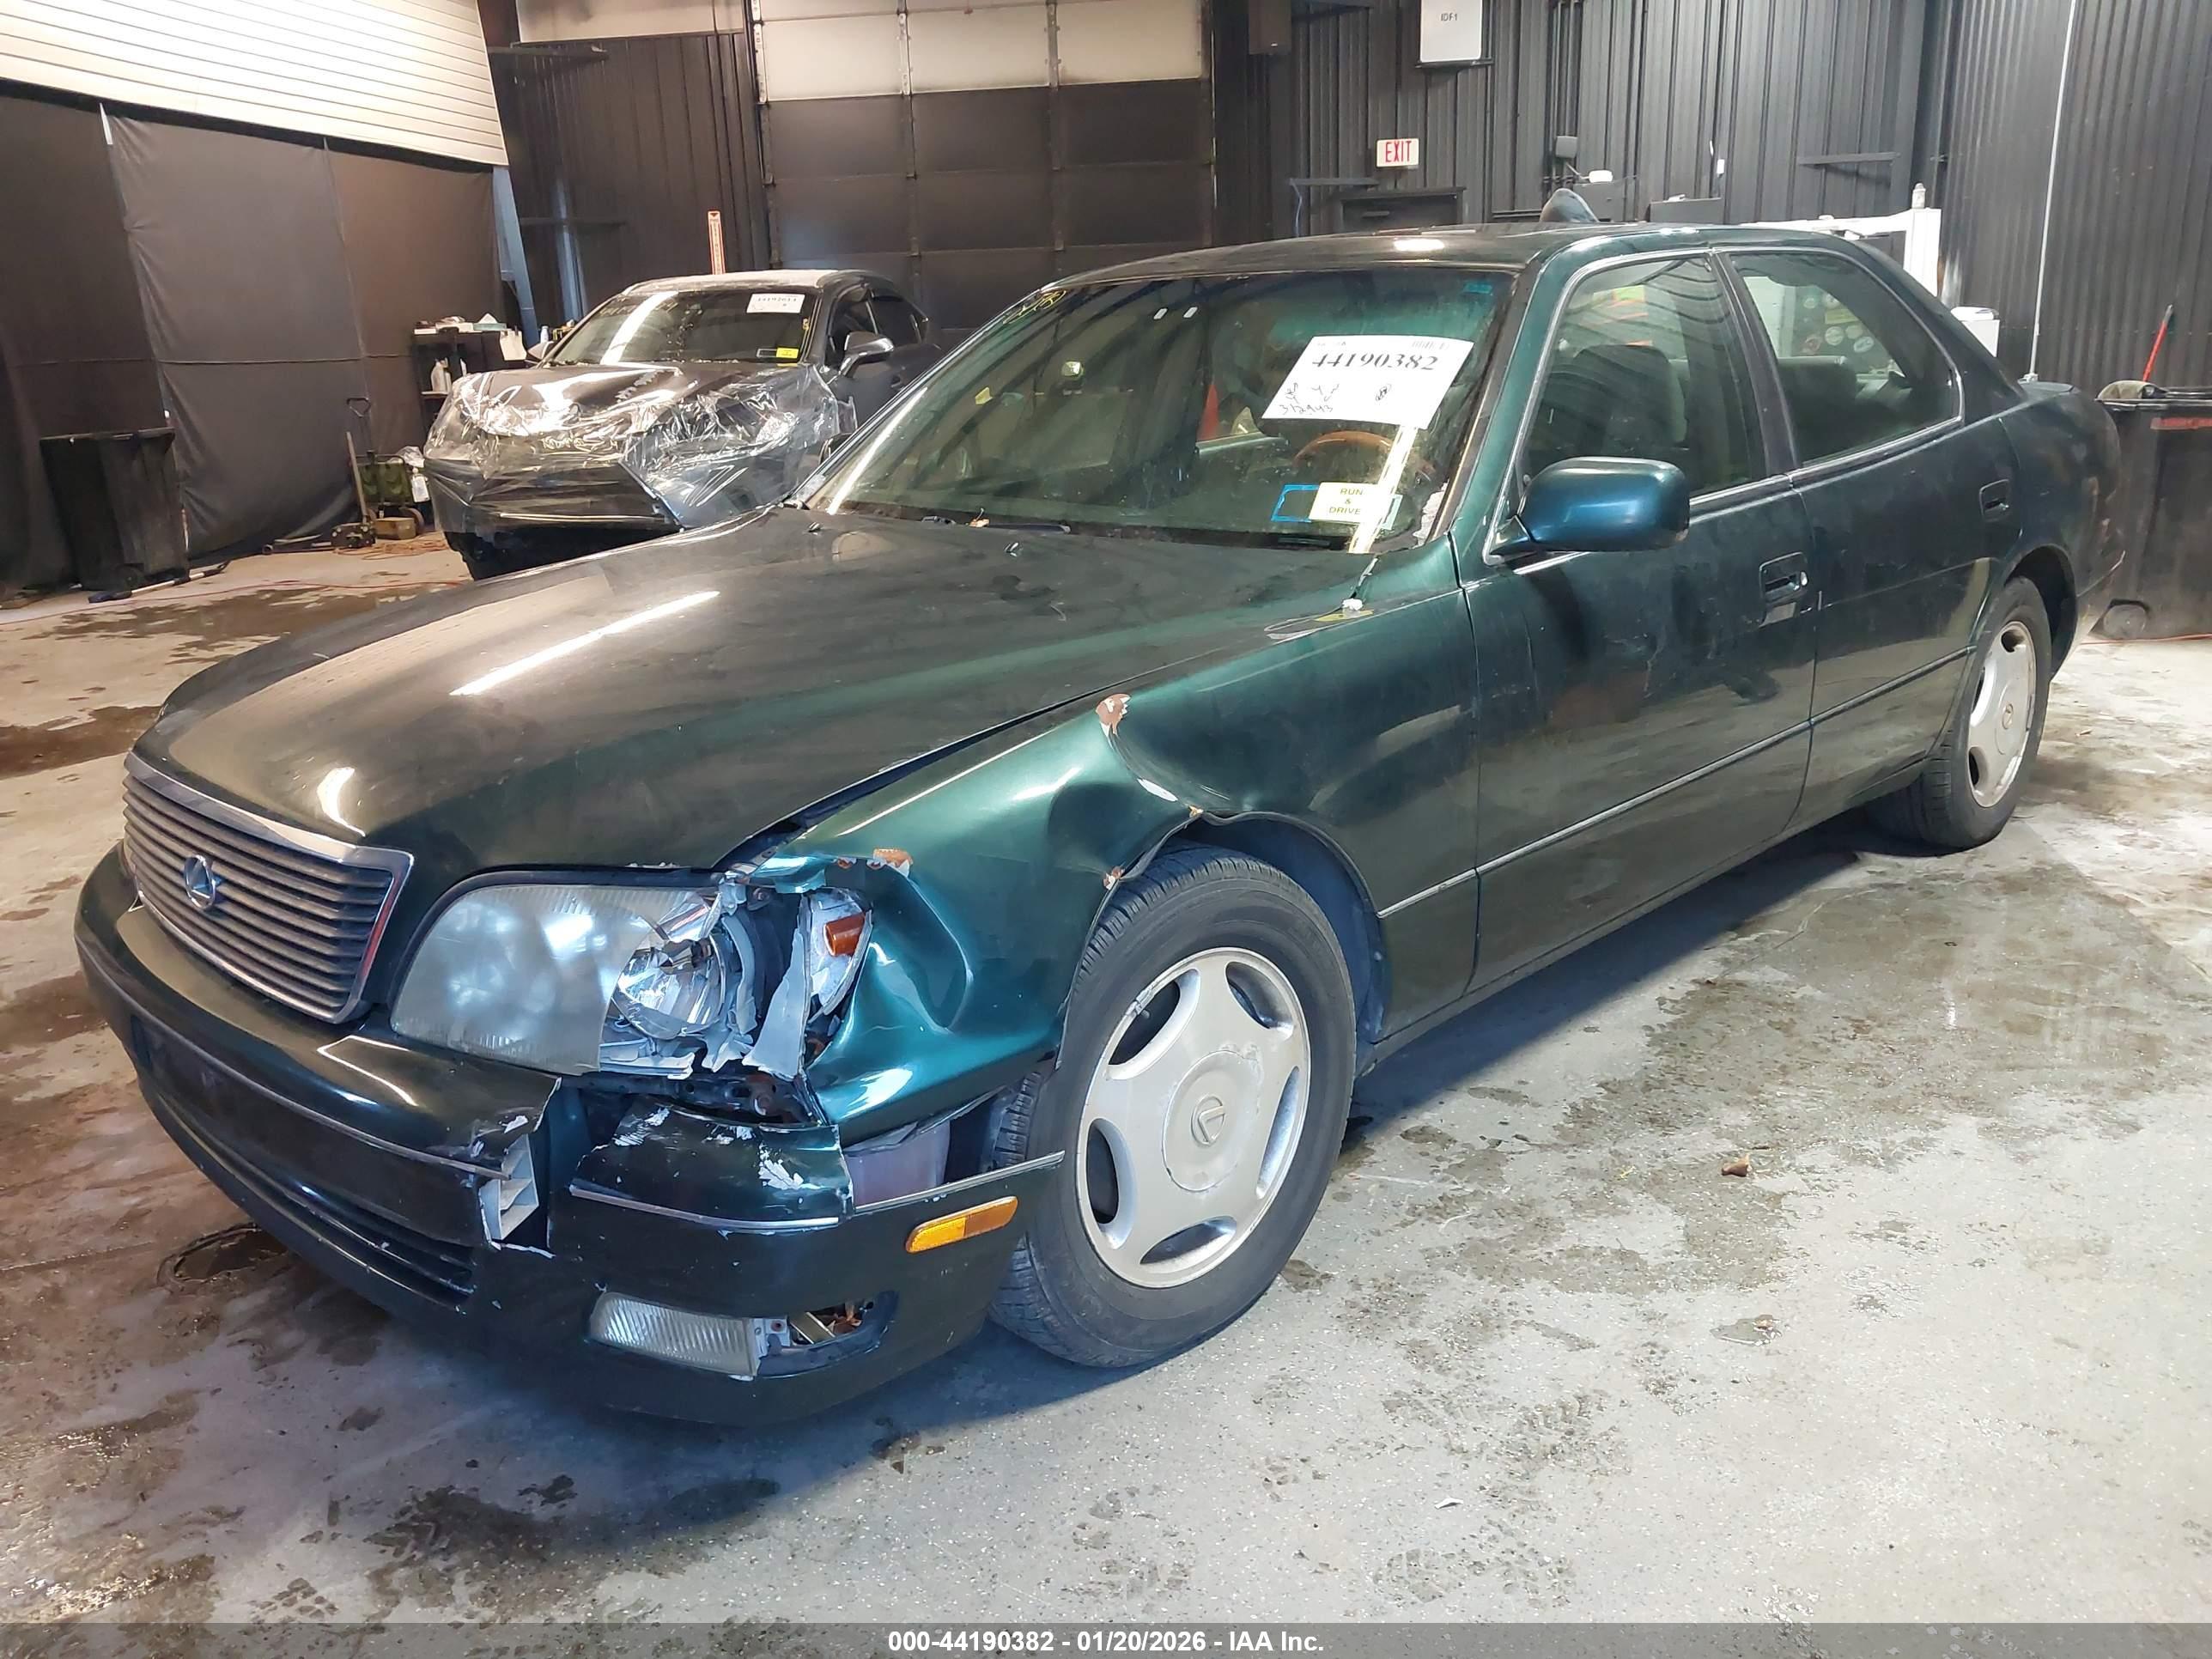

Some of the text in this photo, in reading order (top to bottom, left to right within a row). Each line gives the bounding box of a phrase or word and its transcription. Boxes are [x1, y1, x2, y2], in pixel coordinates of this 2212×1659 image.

[1384, 140, 1413, 163] EXIT
[1311, 352, 1439, 371] 44190382
[1328, 506, 1362, 515] DRIVE
